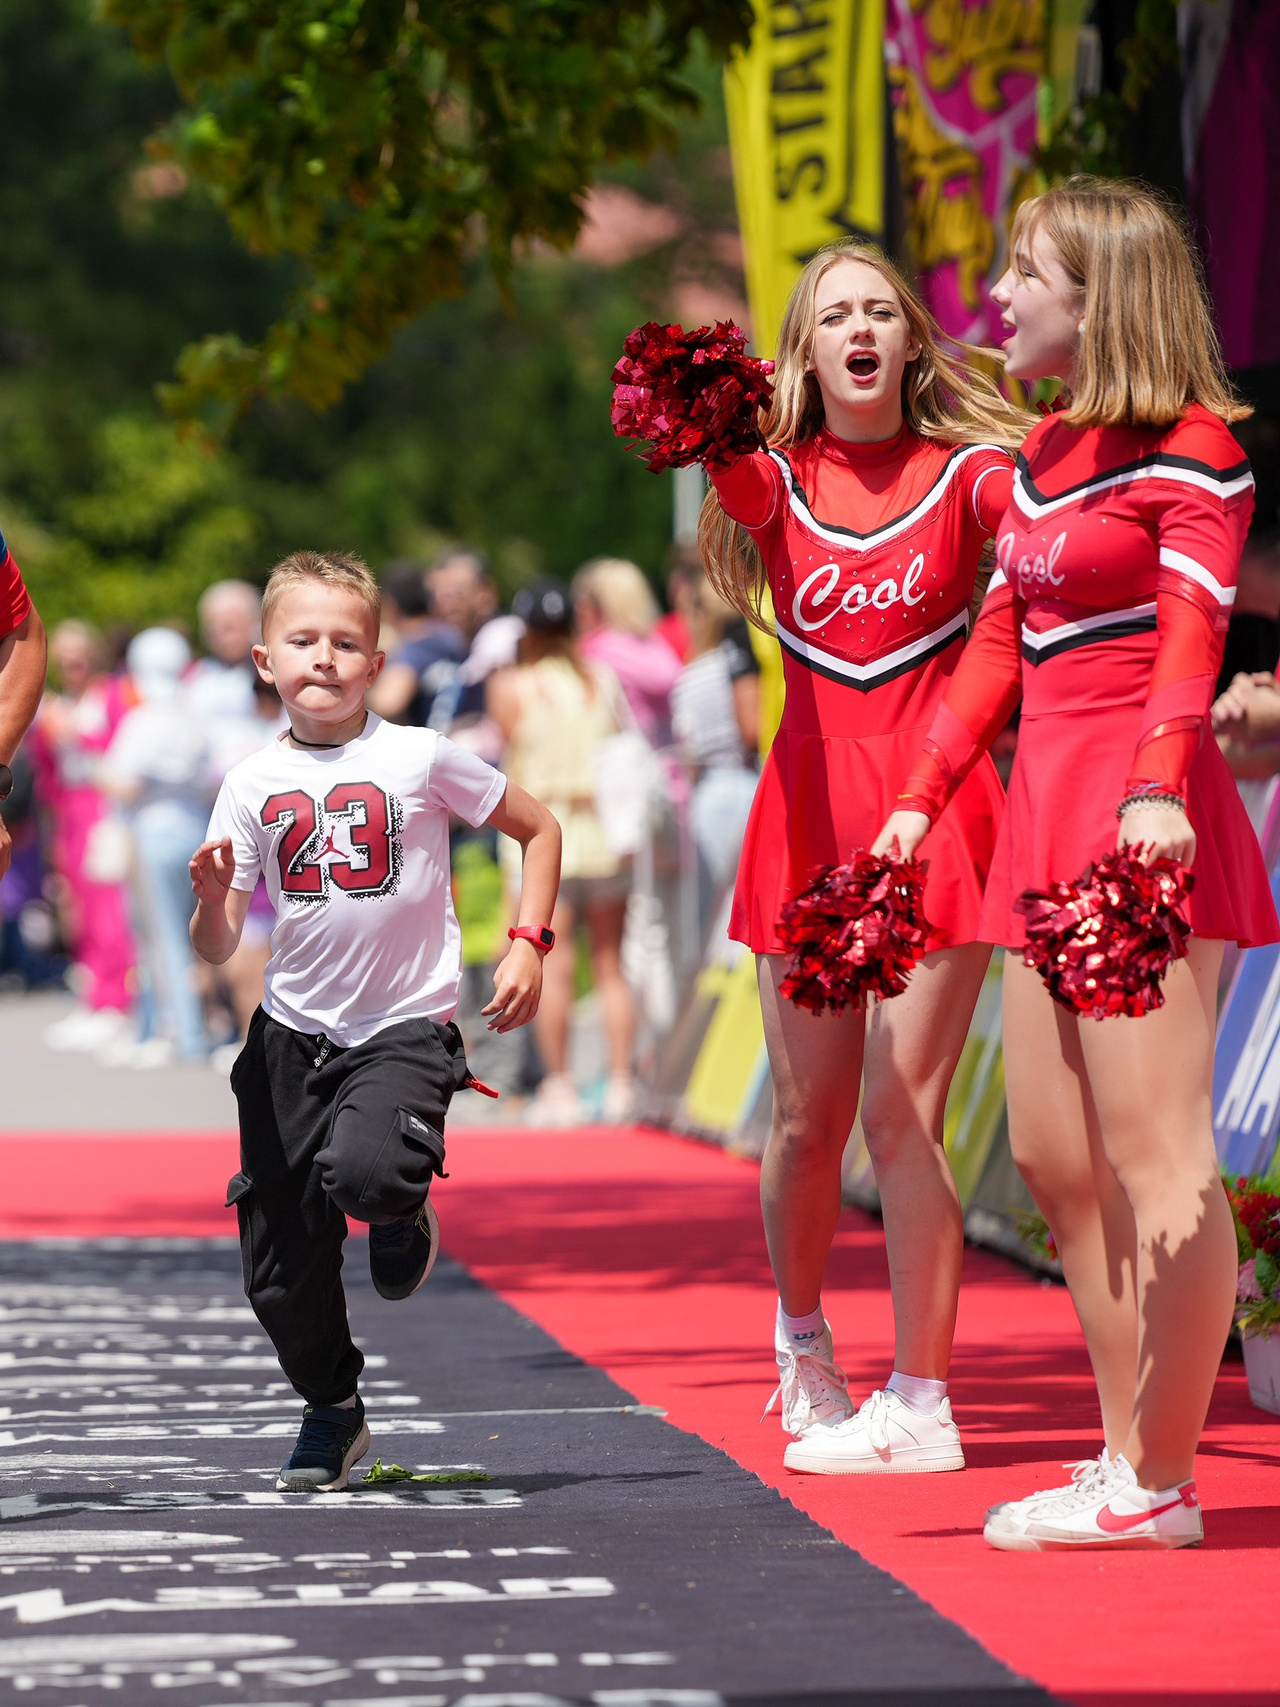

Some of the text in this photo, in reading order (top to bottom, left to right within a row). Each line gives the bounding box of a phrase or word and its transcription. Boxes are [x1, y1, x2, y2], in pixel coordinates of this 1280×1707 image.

[792, 553, 926, 631] Cool
[259, 781, 391, 894] 23
[155, 1576, 615, 1600] STAR
